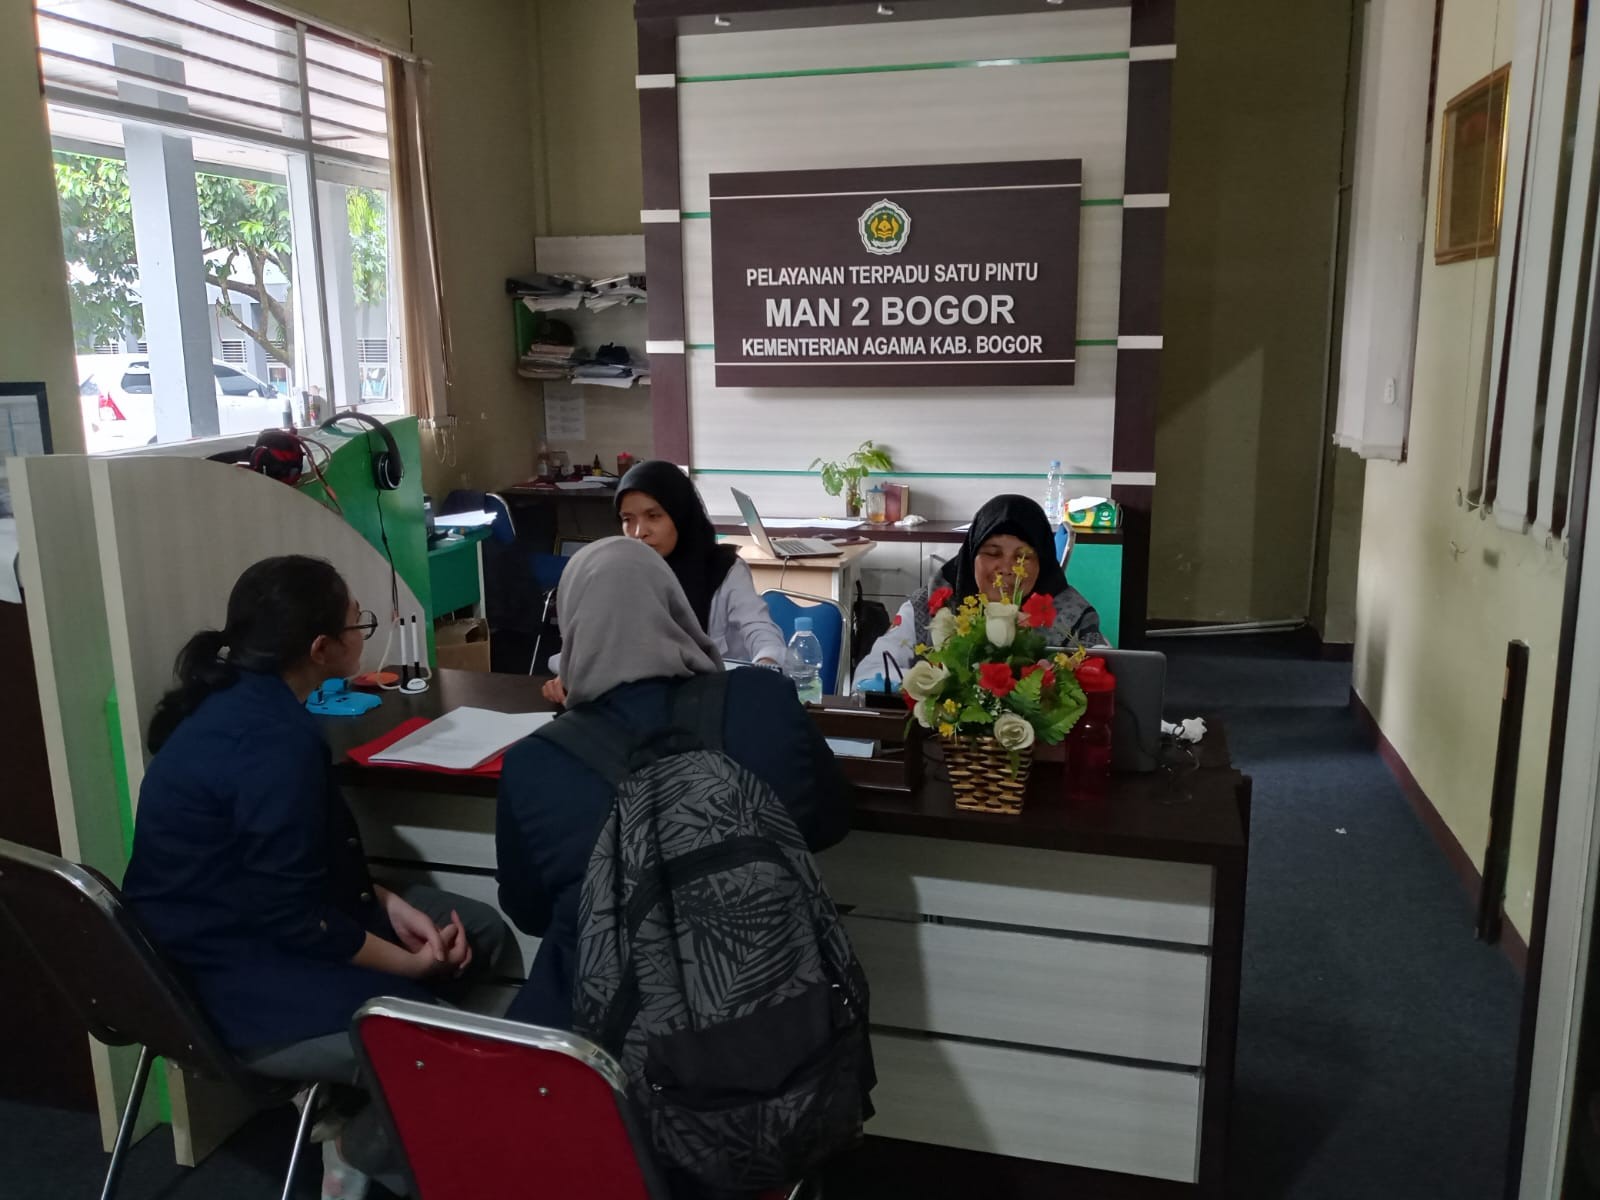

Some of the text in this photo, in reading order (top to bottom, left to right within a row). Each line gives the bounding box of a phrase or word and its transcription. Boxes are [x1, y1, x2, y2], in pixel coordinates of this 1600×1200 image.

[746, 262, 1039, 286] PELAYANAN TERPADU SATU PINTU
[765, 295, 1015, 327] MAN 2 BOGOR
[742, 335, 1043, 356] KEMENTERIAN AGAMA KAB. BOGOR
